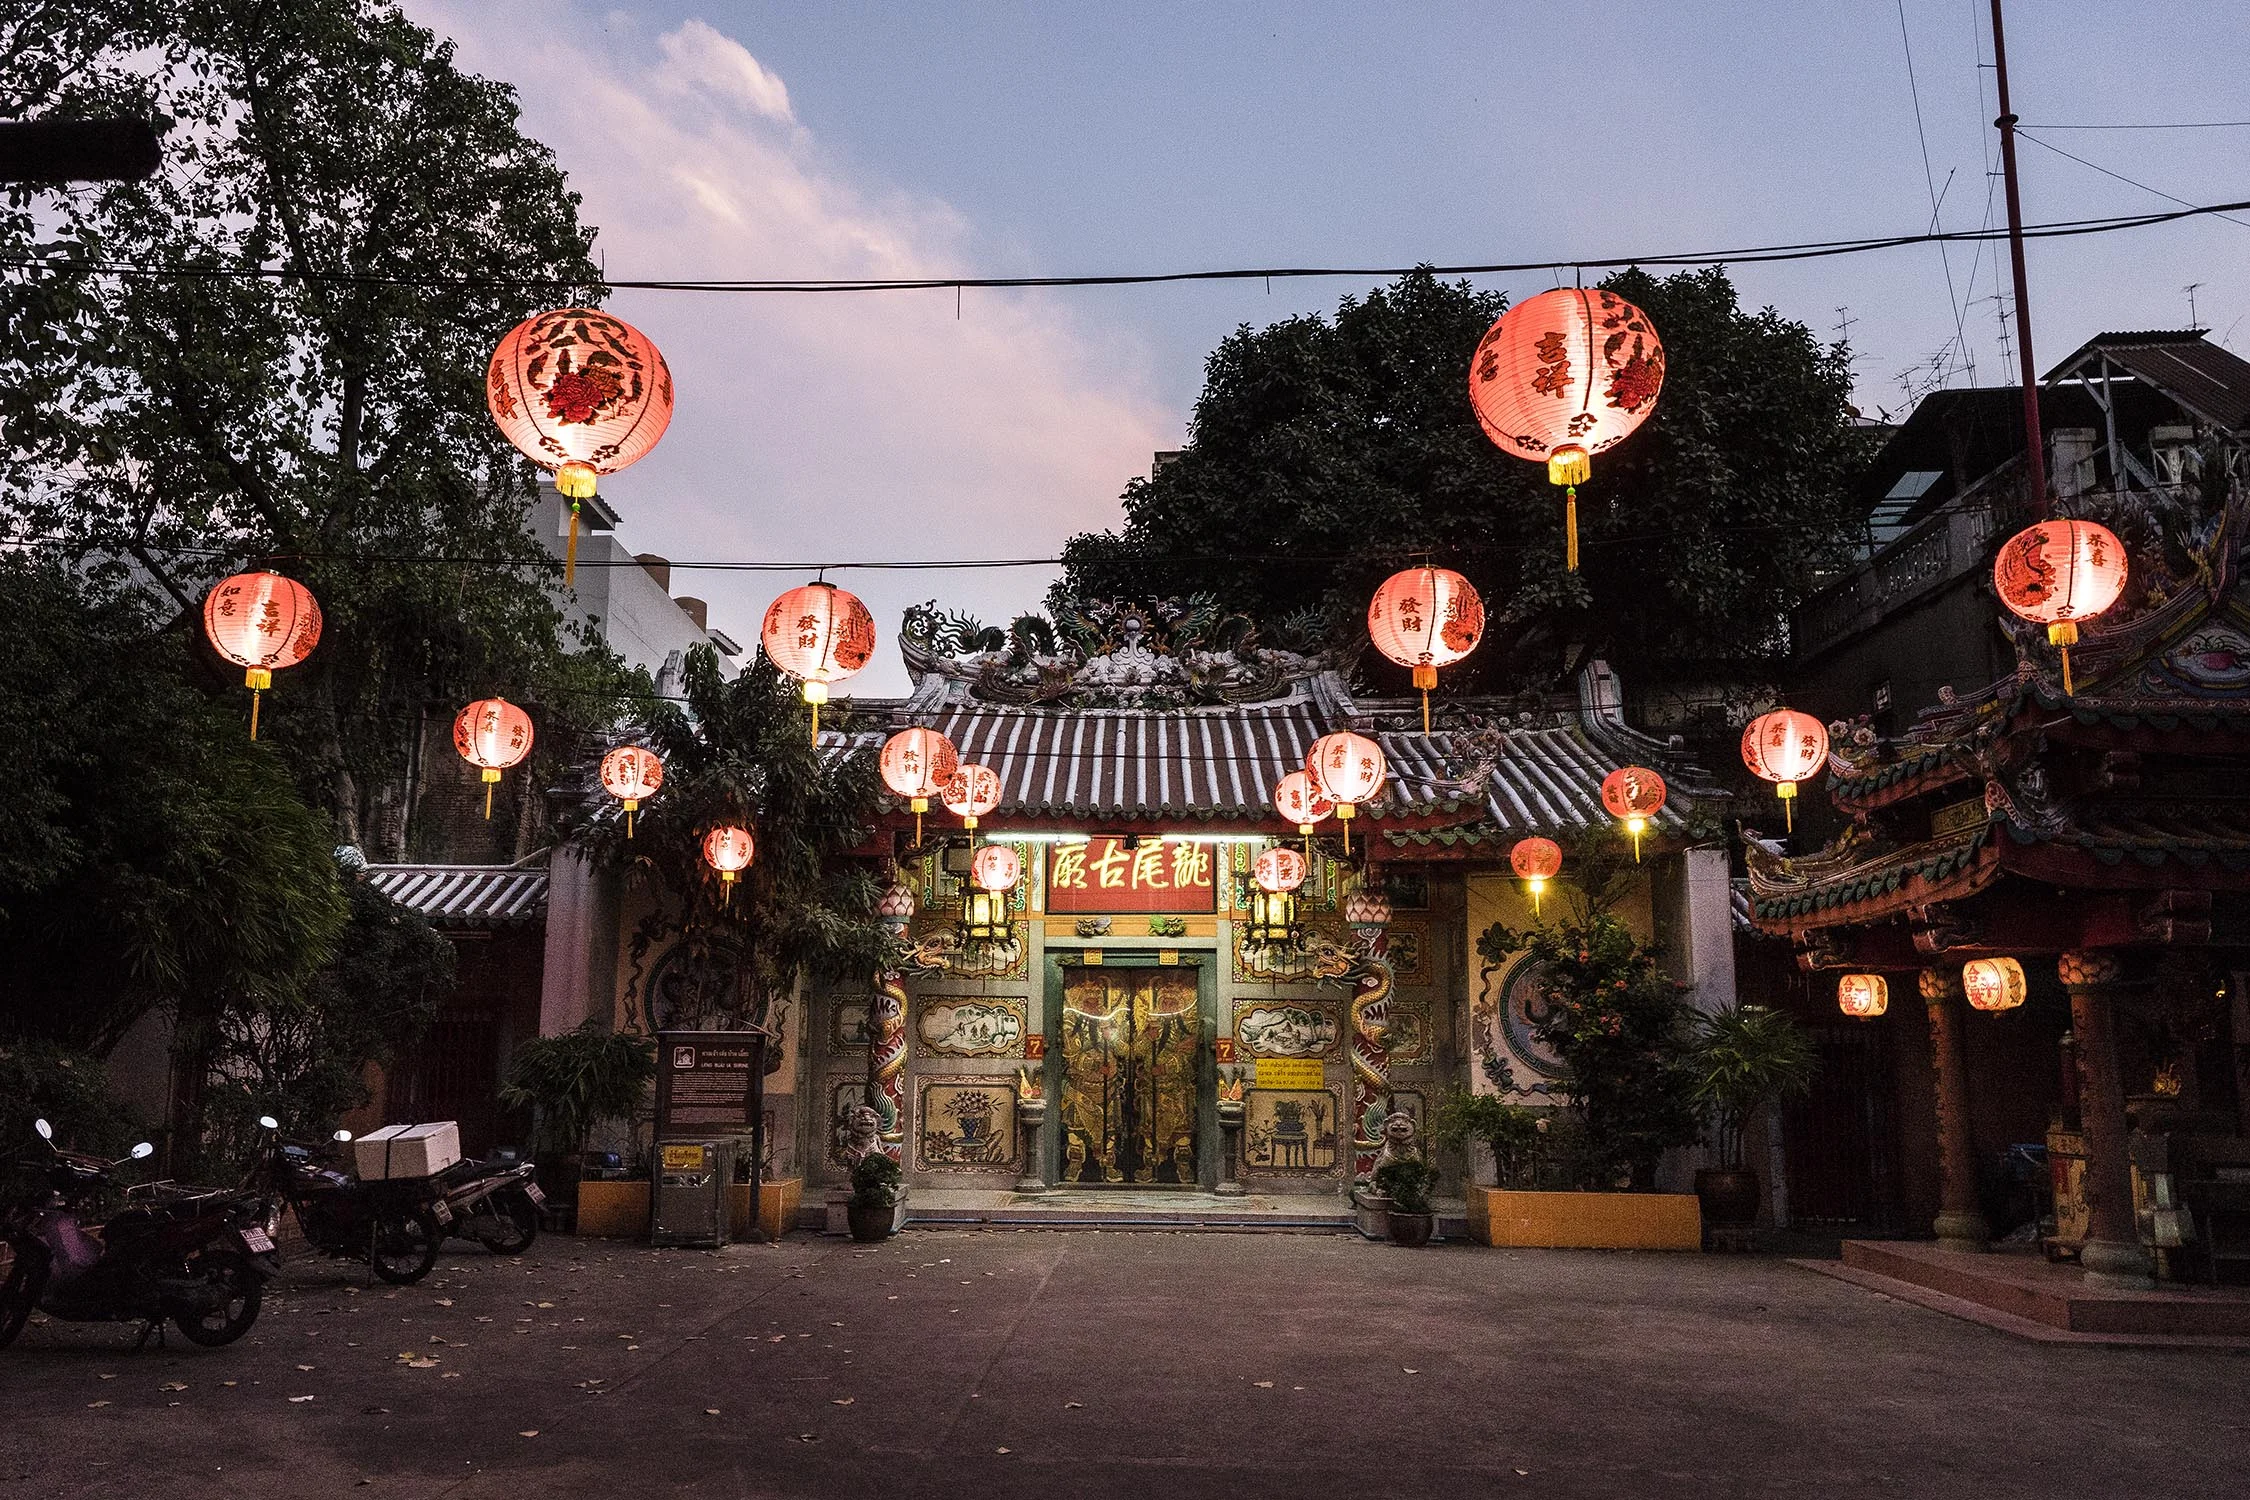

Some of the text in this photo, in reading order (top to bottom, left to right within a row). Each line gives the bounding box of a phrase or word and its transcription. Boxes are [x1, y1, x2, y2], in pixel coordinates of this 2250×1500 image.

[1531, 331, 1575, 400] 吉祥
[2086, 533, 2110, 568] 恭喜
[255, 599, 281, 638] 吉祥
[1398, 596, 1423, 633] 發財
[796, 613, 821, 650] 發財
[902, 749, 920, 775] 發財
[1800, 734, 1818, 761] 發財
[1360, 757, 1375, 783] 發財
[1029, 1039, 1041, 1054] 7
[1219, 1043, 1231, 1058] 7
